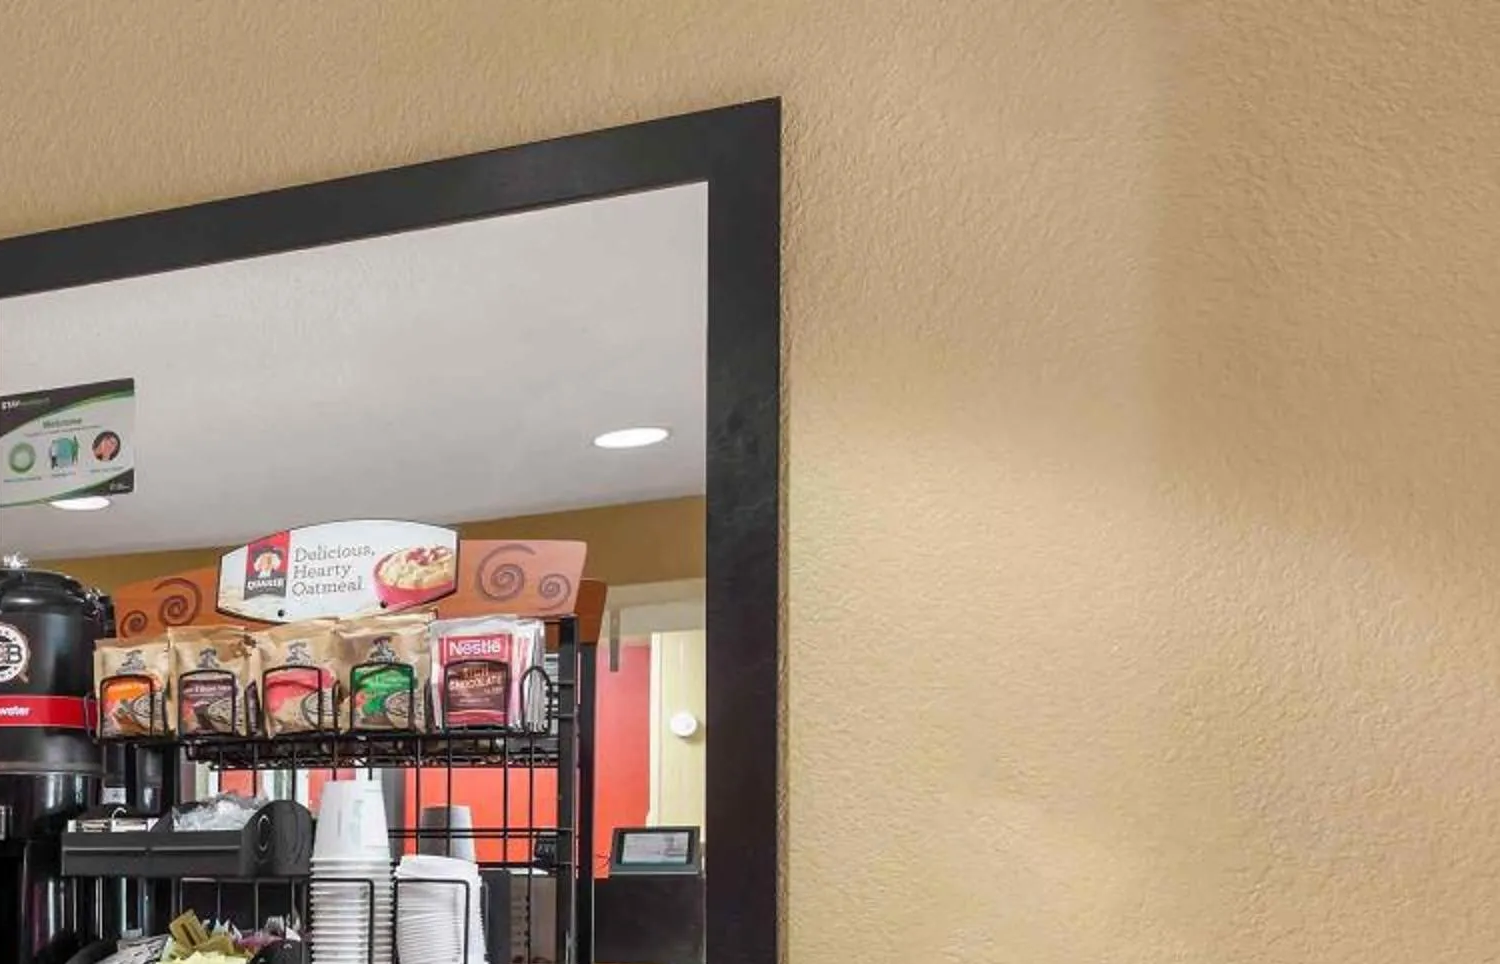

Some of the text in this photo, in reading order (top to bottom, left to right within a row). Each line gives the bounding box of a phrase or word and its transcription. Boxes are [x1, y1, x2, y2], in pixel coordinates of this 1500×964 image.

[295, 544, 376, 562] Delicious,
[294, 564, 352, 579] Hearty
[292, 576, 363, 596] Oatmeal
